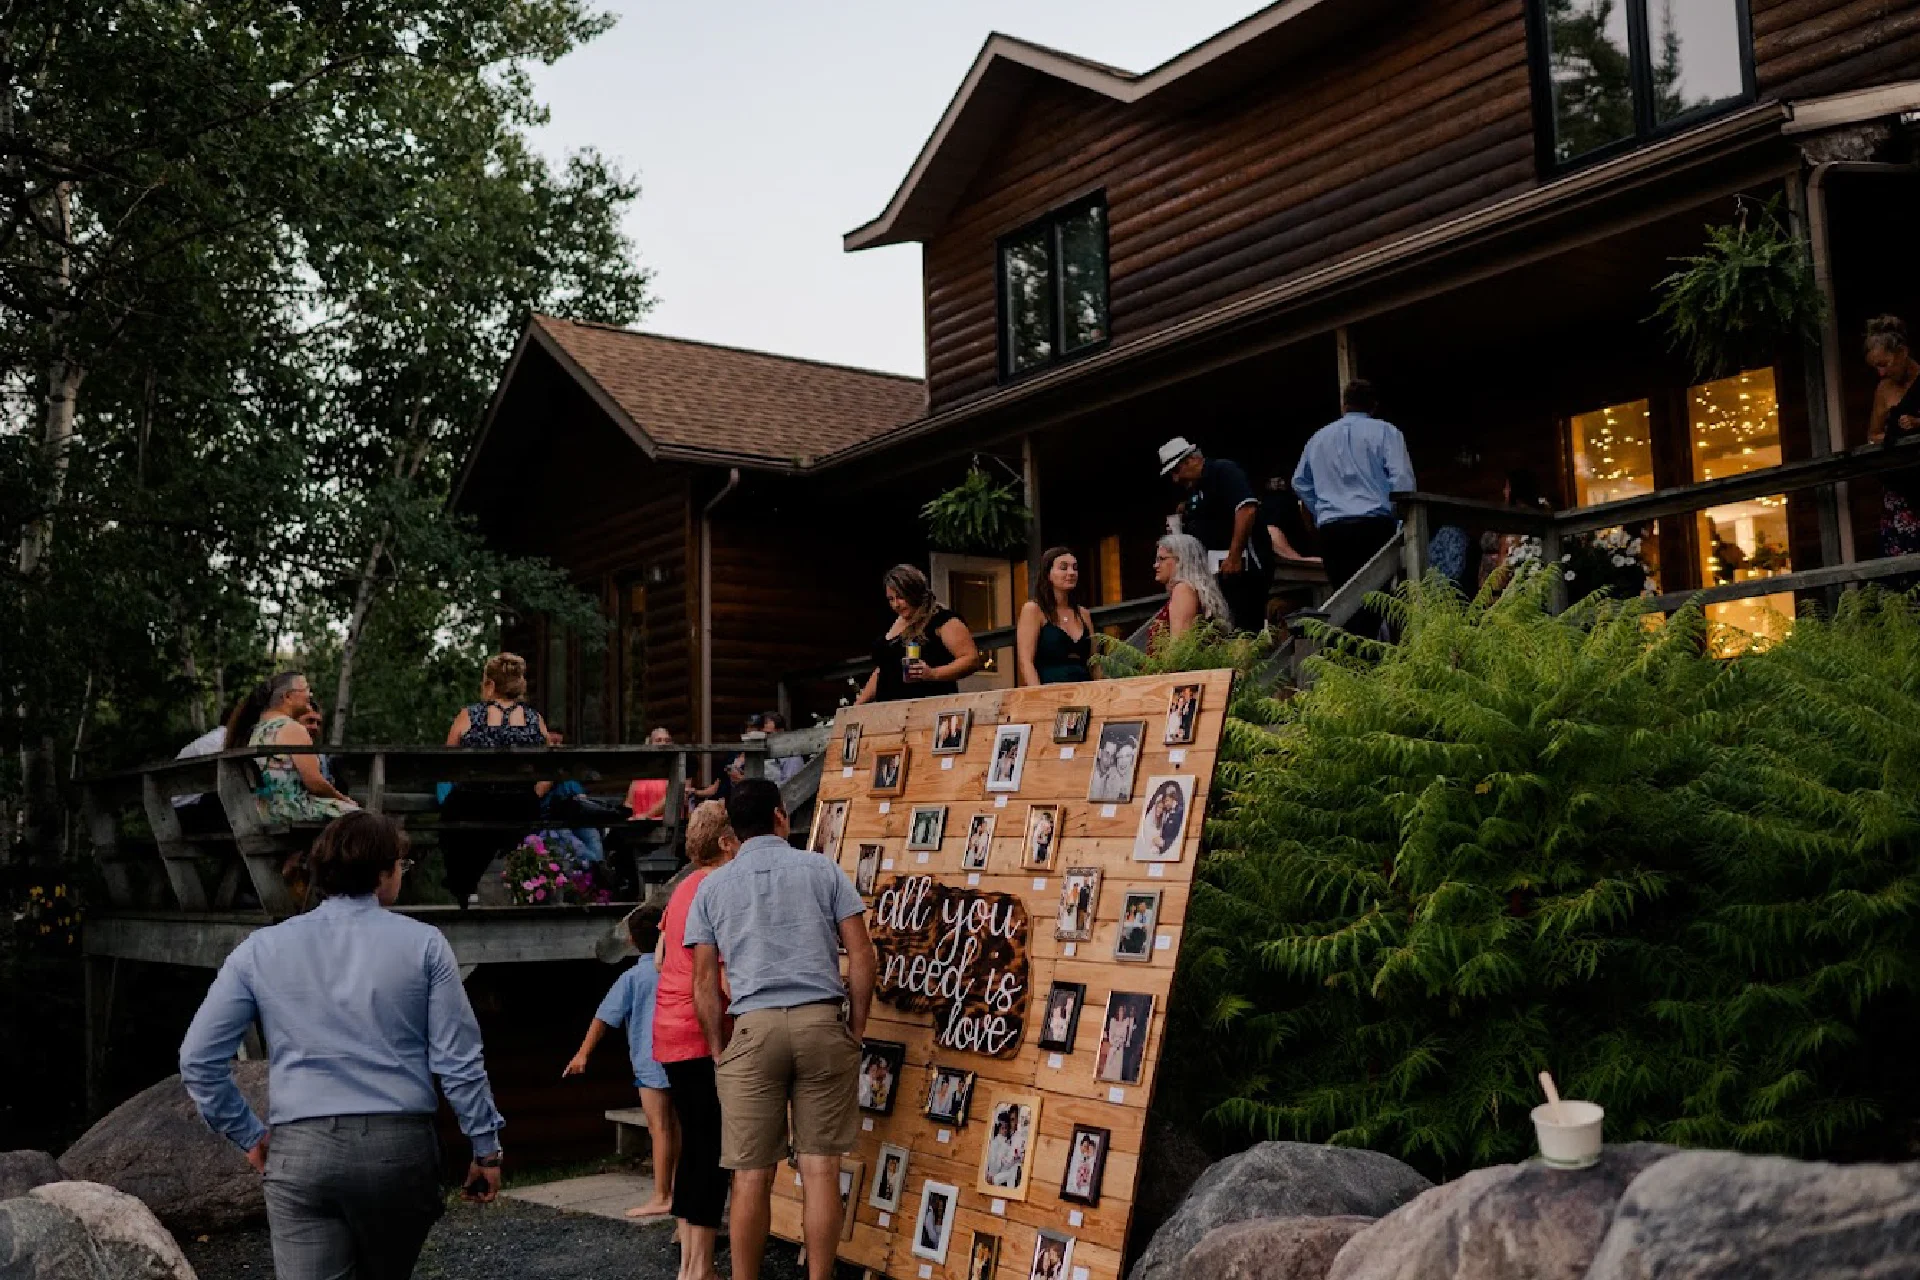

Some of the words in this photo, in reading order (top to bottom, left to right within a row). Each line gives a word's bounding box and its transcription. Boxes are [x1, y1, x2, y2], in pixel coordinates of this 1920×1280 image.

[878, 876, 932, 931] all
[935, 898, 1021, 966] you
[883, 936, 977, 1001] need
[984, 951, 1023, 1012] is
[939, 1000, 1017, 1053] love
